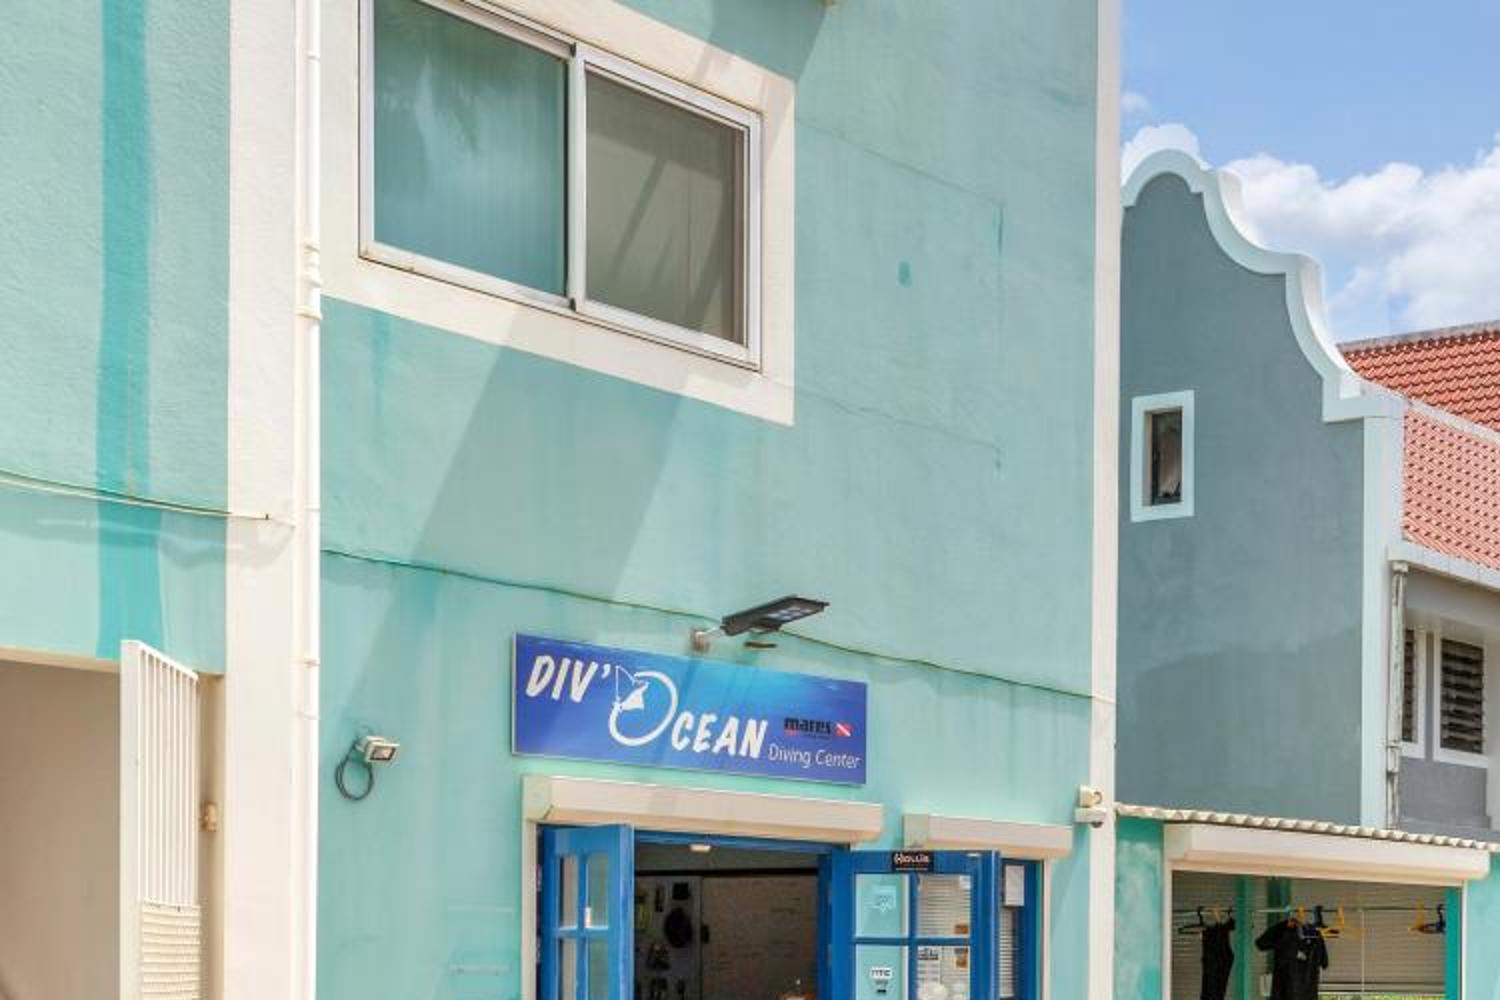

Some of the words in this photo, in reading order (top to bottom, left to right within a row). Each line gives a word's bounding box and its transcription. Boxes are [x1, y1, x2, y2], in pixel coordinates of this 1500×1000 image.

[525, 655, 611, 703] DIV'
[783, 717, 832, 735] mares
[768, 743, 811, 769] Diving
[815, 749, 862, 769] Center
